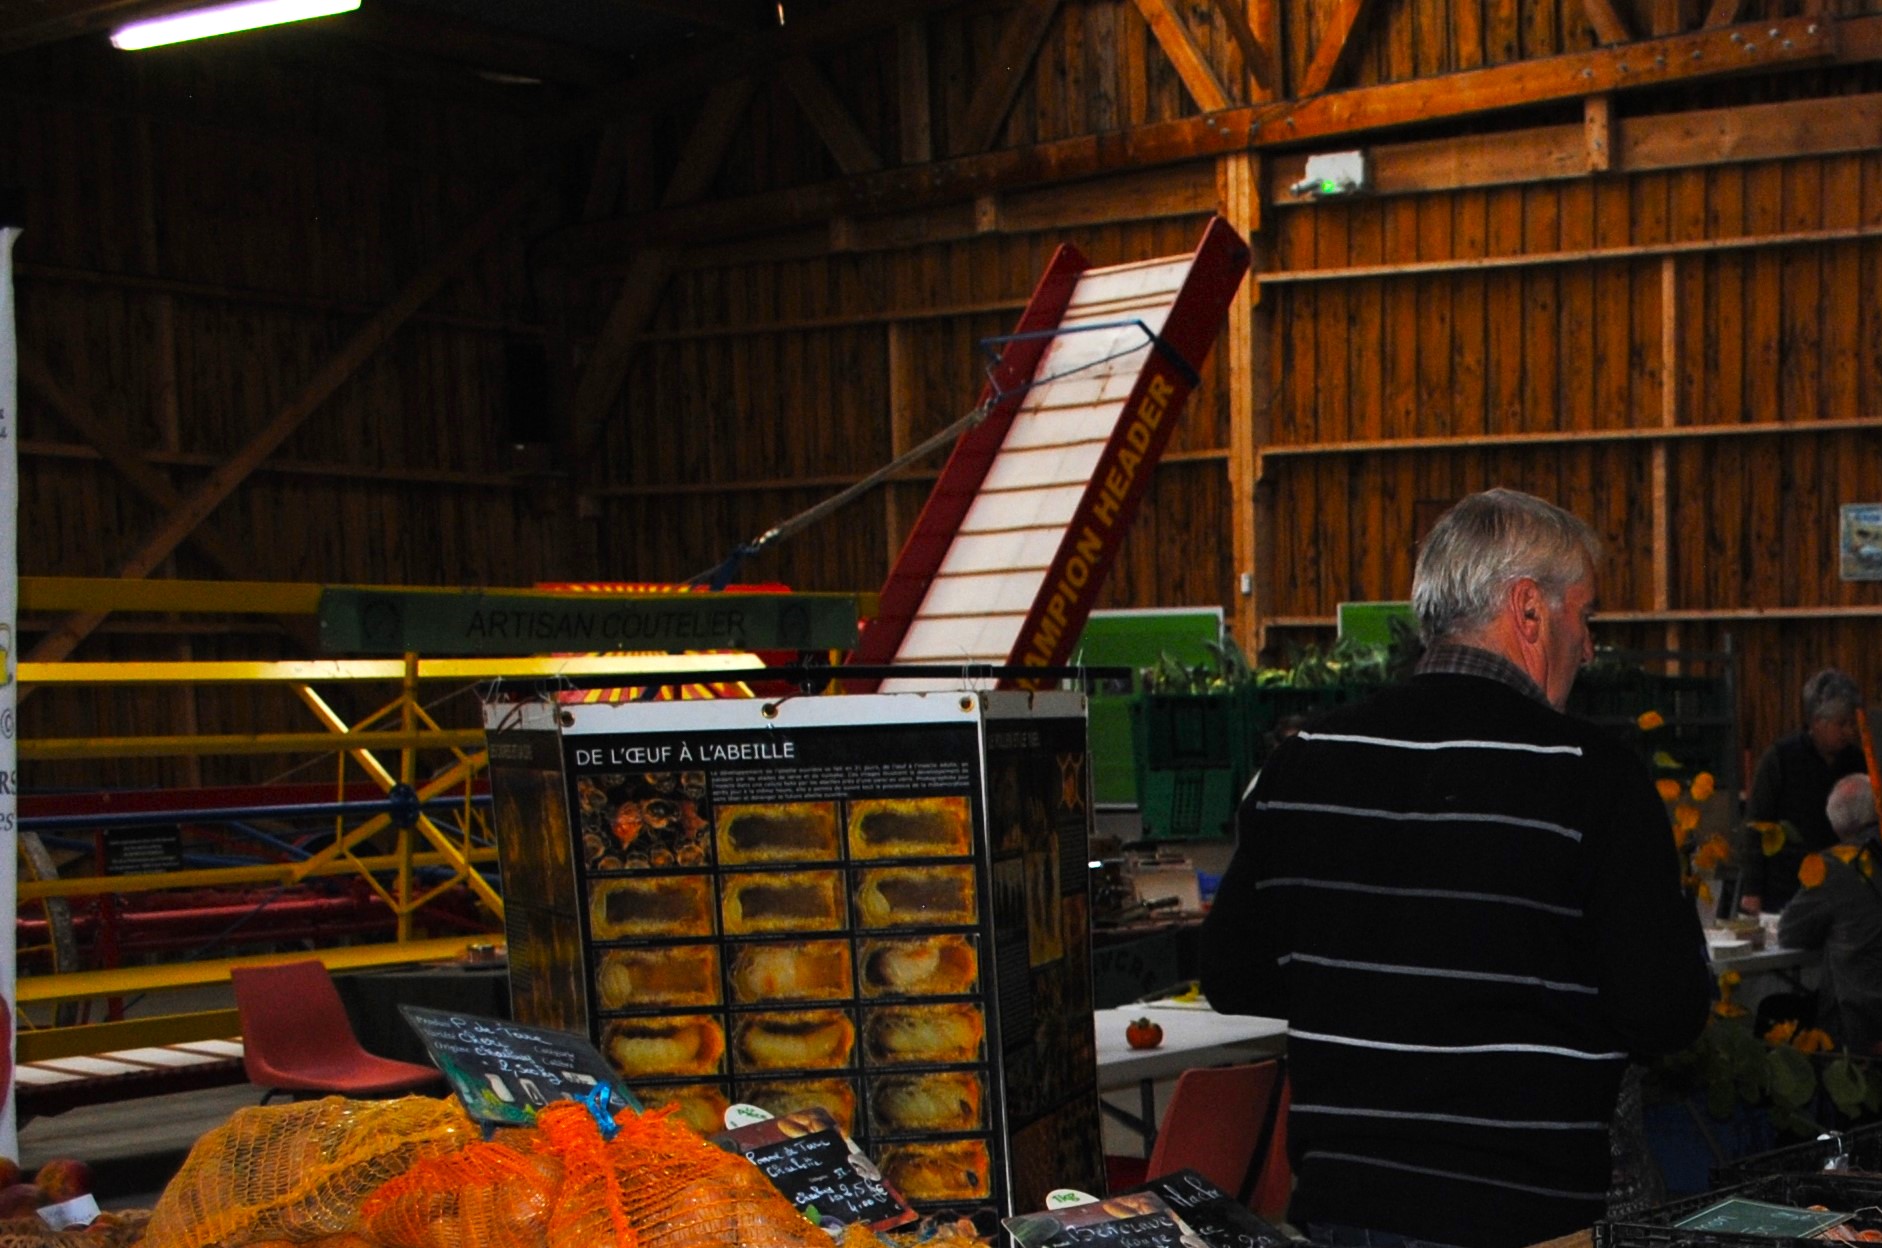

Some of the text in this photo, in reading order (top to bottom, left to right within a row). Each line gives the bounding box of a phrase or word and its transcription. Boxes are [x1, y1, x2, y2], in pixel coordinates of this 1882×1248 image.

[1093, 374, 1175, 528] HEADER
[466, 610, 747, 640] ARTISAN COUTELIER
[576, 747, 605, 768] DE
[679, 740, 694, 763] À
[699, 740, 796, 763] L'ABEILLE
